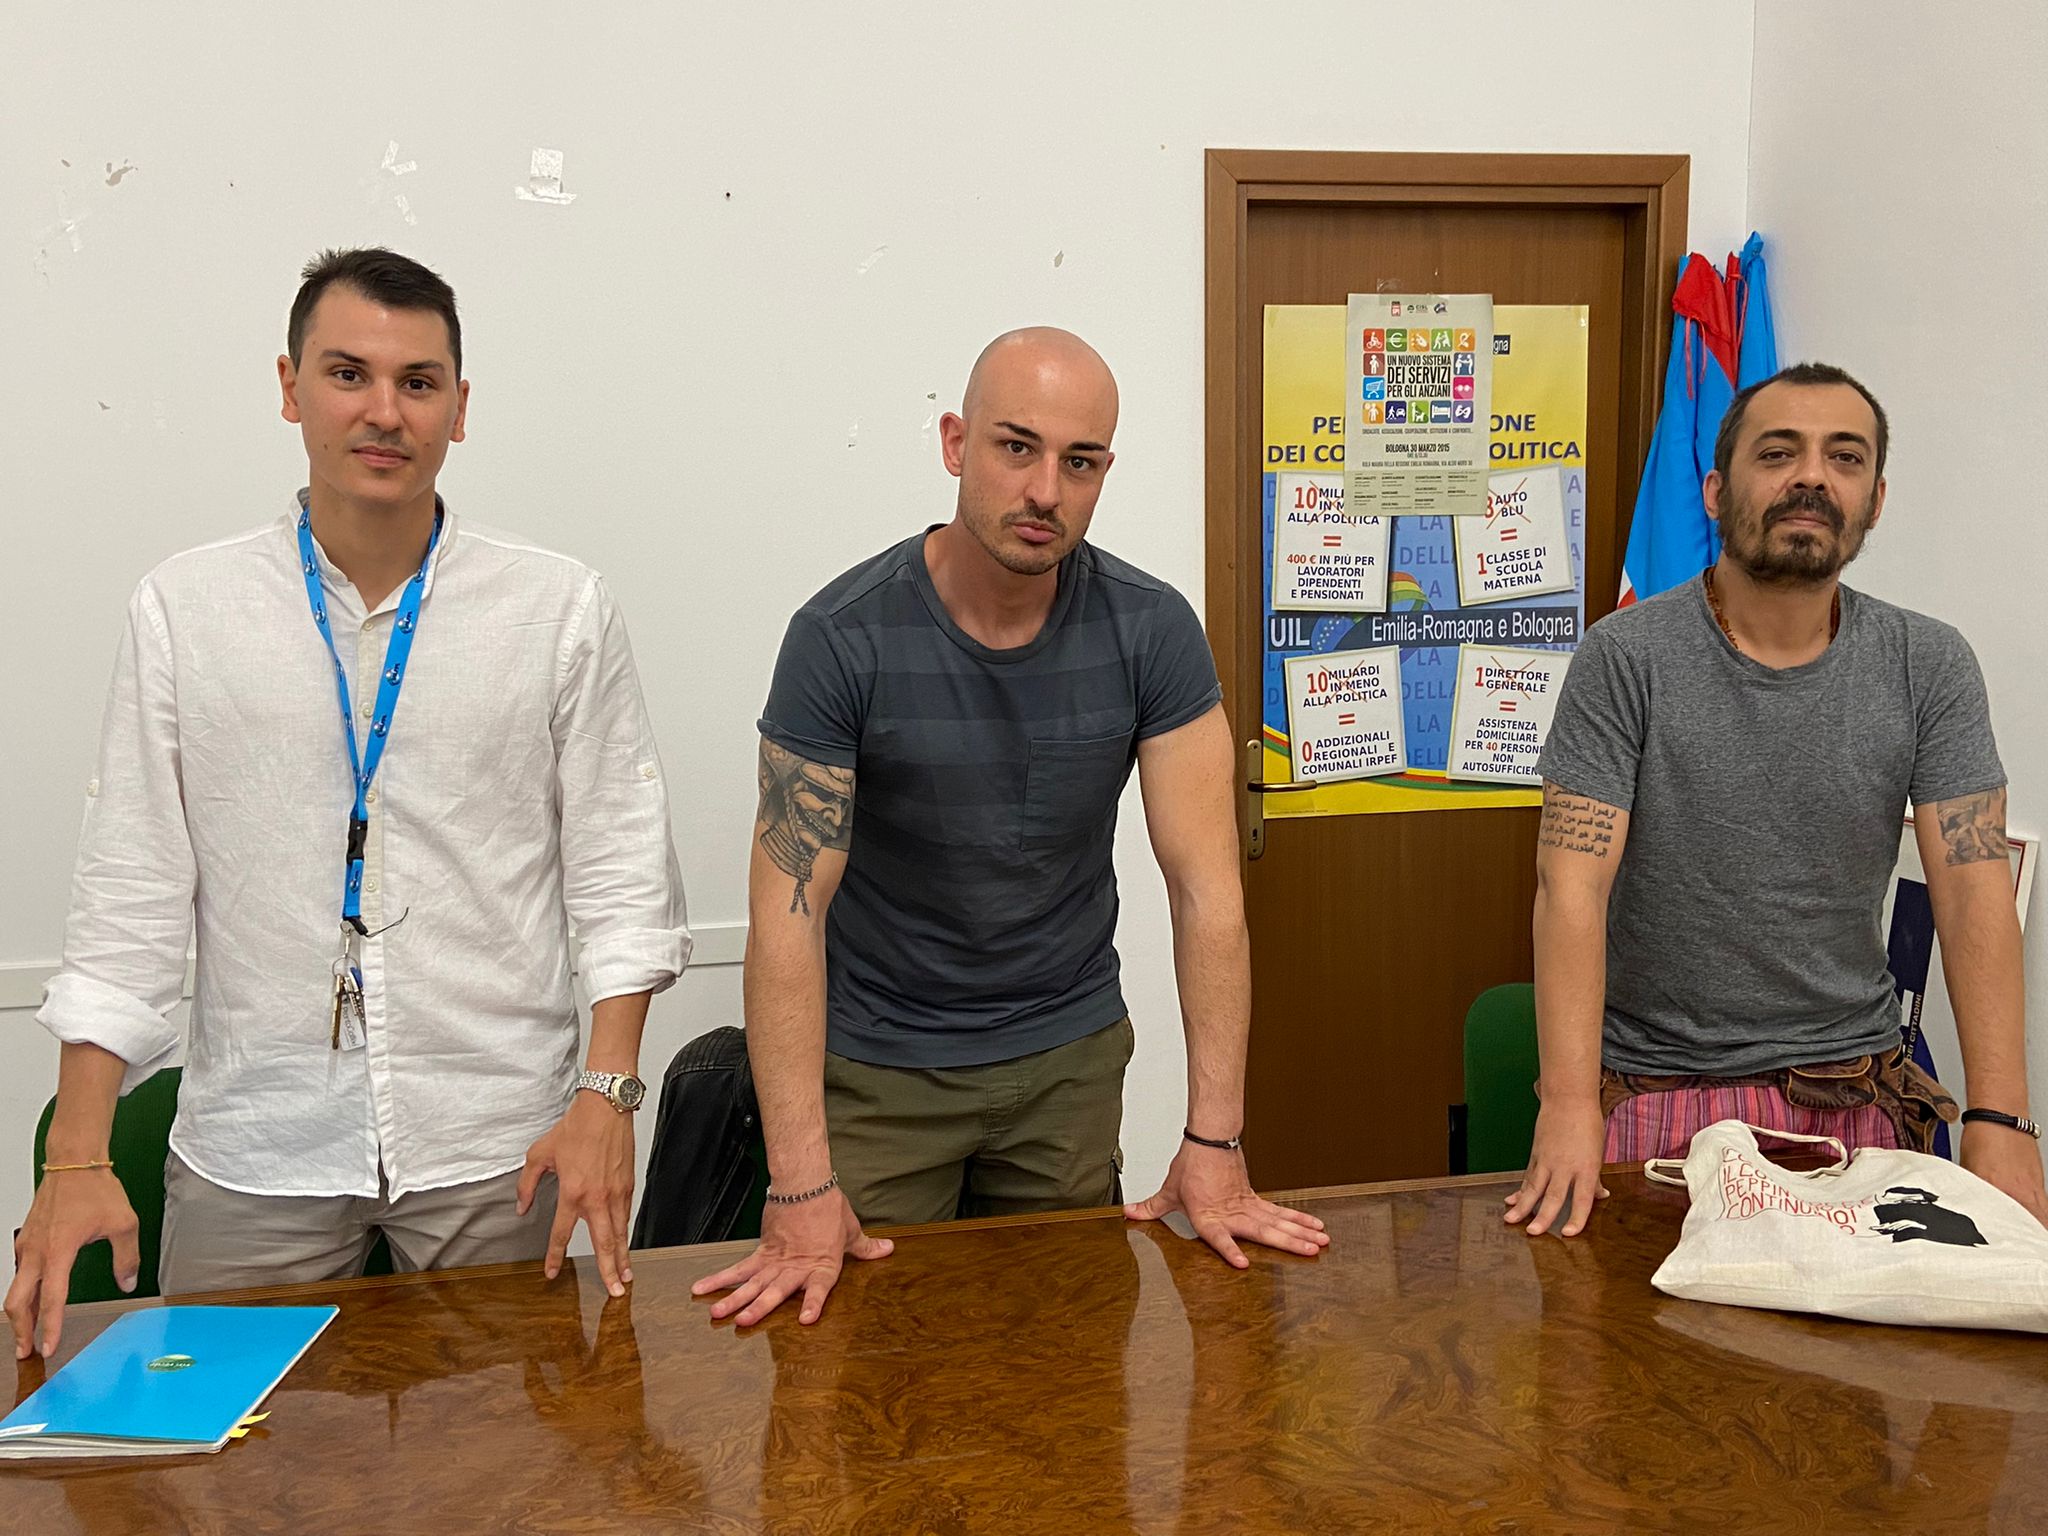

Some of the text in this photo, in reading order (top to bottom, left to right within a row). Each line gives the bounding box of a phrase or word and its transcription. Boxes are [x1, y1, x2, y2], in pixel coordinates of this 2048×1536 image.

[1493, 339, 1509, 354] gna
[1387, 355, 1451, 366] UN NUOVO SISTEMA
[1388, 366, 1451, 384] DEI SERVIZI
[1387, 385, 1451, 398] PER GLI ANZIANI
[1313, 416, 1345, 434] PE
[1490, 414, 1536, 432] ONE
[1268, 445, 1345, 463] DEI CO
[1386, 443, 1450, 453] BOLOGNA 30 MARZO 2015
[1489, 442, 1581, 459] OLITICA
[1295, 487, 1318, 510] 10
[1319, 488, 1344, 499] MILI
[1495, 491, 1528, 505] AUTO
[1320, 501, 1331, 511] IN
[1501, 505, 1524, 517] BLU
[1287, 513, 1319, 523] ALLA
[1323, 514, 1379, 525] POLITICA
[1287, 554, 1375, 566] 400 € IN PIÙ PER
[1400, 546, 1455, 564] DELL
[1487, 547, 1547, 565] CLASSE DI
[1297, 566, 1365, 577] LAVORATORI
[1477, 553, 1487, 575] 1
[1496, 560, 1544, 576] SCUOLA
[1298, 578, 1361, 588] DIPENDENTI
[1484, 573, 1542, 591] MATERNA
[1291, 589, 1364, 600] E PENSIONATI
[1271, 617, 1310, 647] UIL
[1372, 611, 1574, 645] Emilia-Romagna e Bologna
[1328, 665, 1380, 680] MILIARDI
[1475, 667, 1484, 687] 1
[1485, 668, 1550, 681] DIRETTORE
[1307, 671, 1328, 694] 10
[1330, 677, 1380, 692] IN MENO
[1486, 680, 1547, 693] GENERALE
[1303, 689, 1388, 707] ALLA POLITICA
[1478, 718, 1538, 731] ASSISTENZA
[1316, 731, 1390, 749] ADDIZIONALI
[1476, 730, 1538, 743] DOMICILIARE
[1302, 741, 1312, 762] 0
[1314, 743, 1395, 761] REGIONALI E
[1465, 740, 1483, 750] PER
[1486, 741, 1498, 751] 40
[1302, 754, 1398, 775] COMUNALI IRPEF
[1492, 753, 1514, 763] NON
[1462, 762, 1538, 776] AUTOSUFFICIEN
[1909, 993, 1923, 1042] CITTADINI
[1725, 1178, 1789, 1205] PEPPIN
[1727, 1192, 1812, 1219] CONTINU
